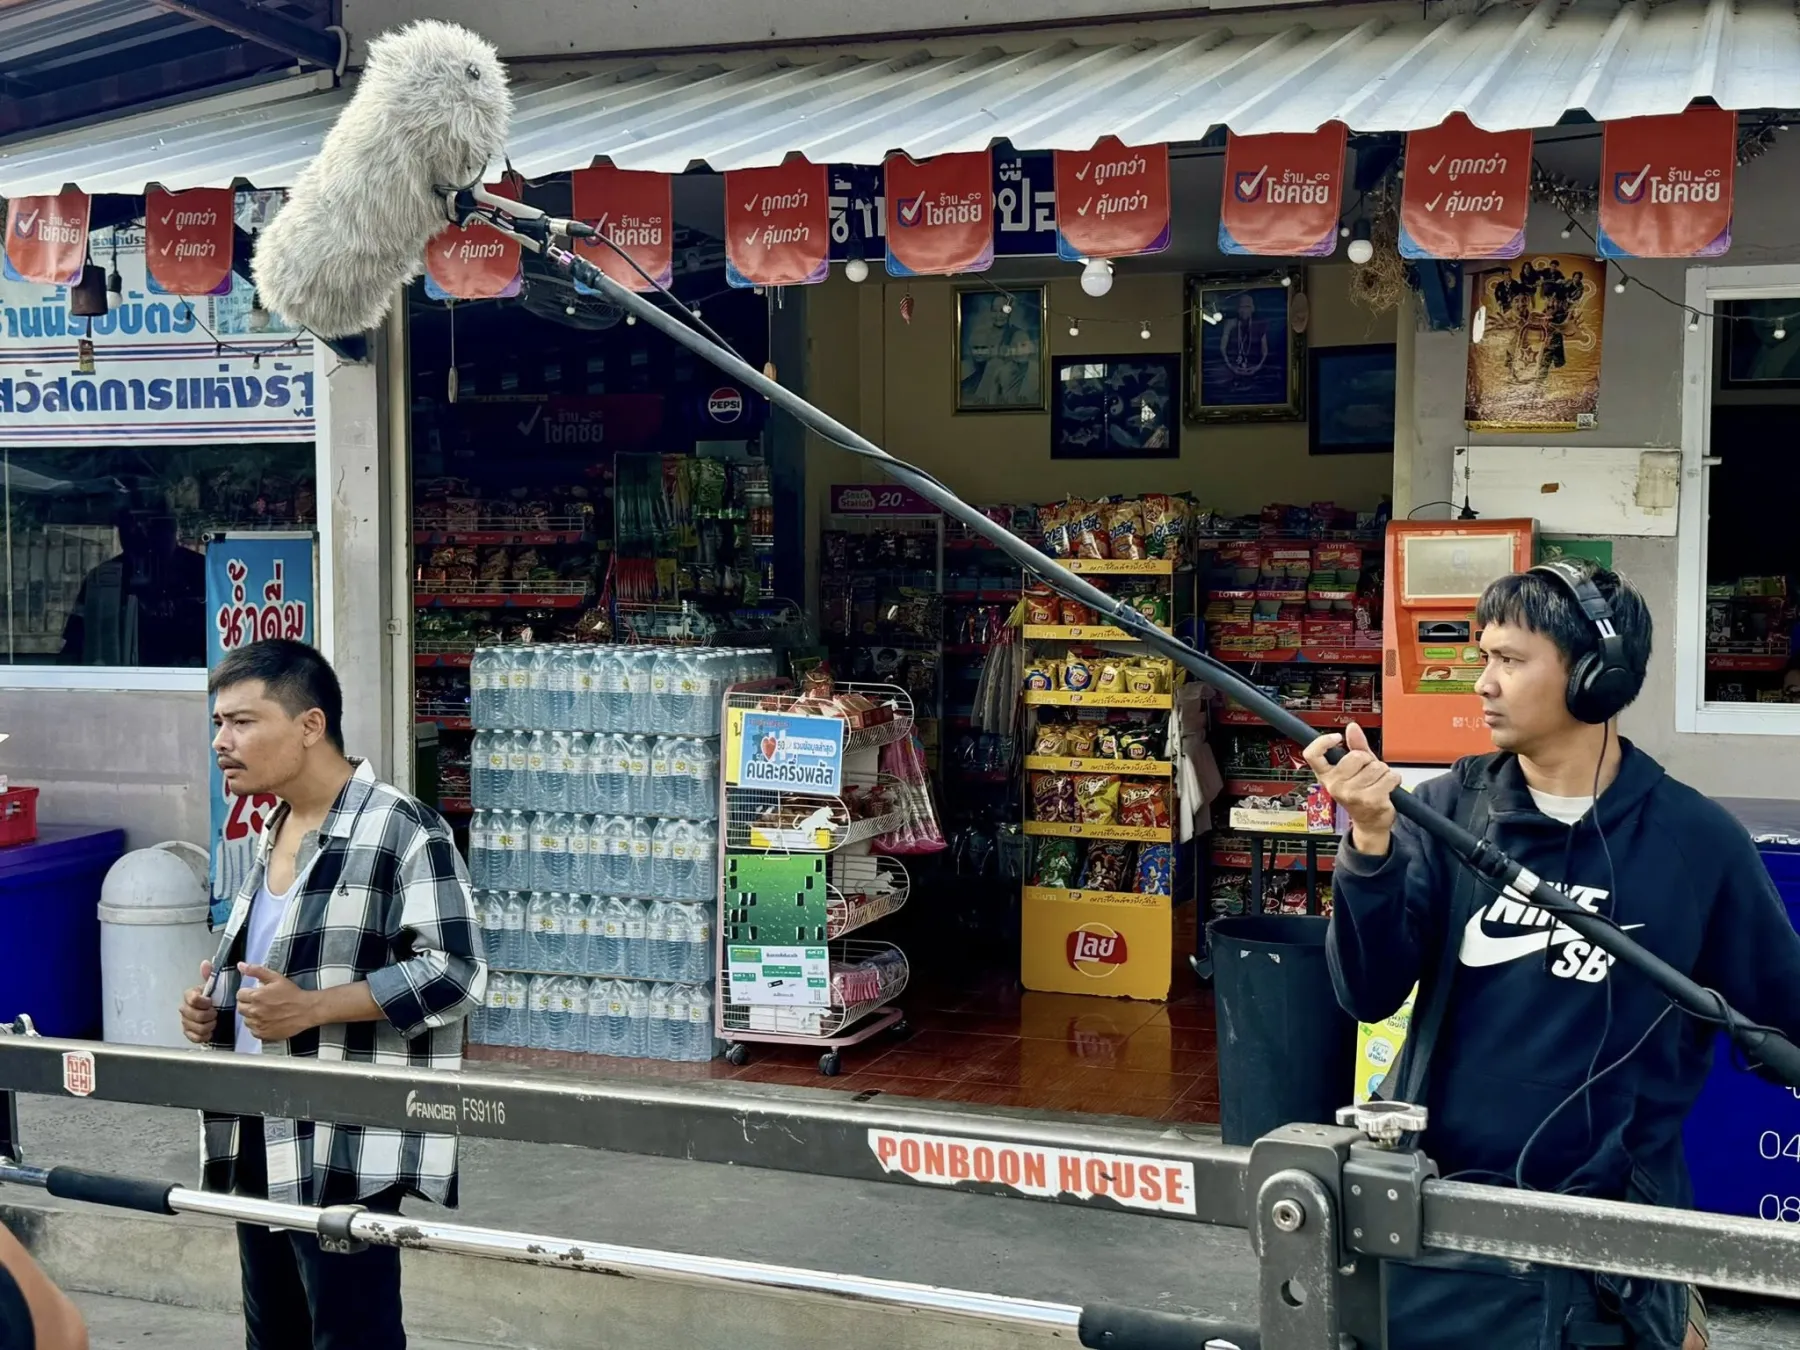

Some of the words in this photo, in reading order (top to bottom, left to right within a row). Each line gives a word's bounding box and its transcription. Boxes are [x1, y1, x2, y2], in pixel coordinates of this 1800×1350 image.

[1095, 158, 1146, 186] ถูกกว่า
[1448, 154, 1507, 182] ถูกกว่า
[1265, 176, 1329, 204] โชคชัย
[1650, 174, 1721, 203] โชคชัย
[761, 190, 809, 217] ถูกกว่า
[925, 199, 982, 226] โชคชัย
[1095, 193, 1148, 220] คุ้มกว่า
[1445, 192, 1504, 219] คุ้มกว่า
[38, 220, 80, 244] โชคชัย
[175, 209, 217, 231] ถูกกว่า
[608, 222, 663, 247] โชคชัย
[762, 228, 809, 254] คุ้มกว่า
[175, 240, 216, 261] คุ้มกว่า
[459, 240, 505, 265] คุ้มกว่า
[710, 400, 740, 409] PEPSI
[217, 559, 306, 651] น้ำดื่ม
[746, 755, 834, 786] คนละครึ่งพลัส
[1551, 940, 1616, 983] SB
[416, 1102, 456, 1121] FANCIER
[462, 1097, 506, 1124] FS9116
[1760, 1130, 1800, 1162] 04
[877, 1136, 1046, 1188] PONBOON
[1058, 1155, 1185, 1204] HOUSE
[1760, 1194, 1800, 1223] 08
